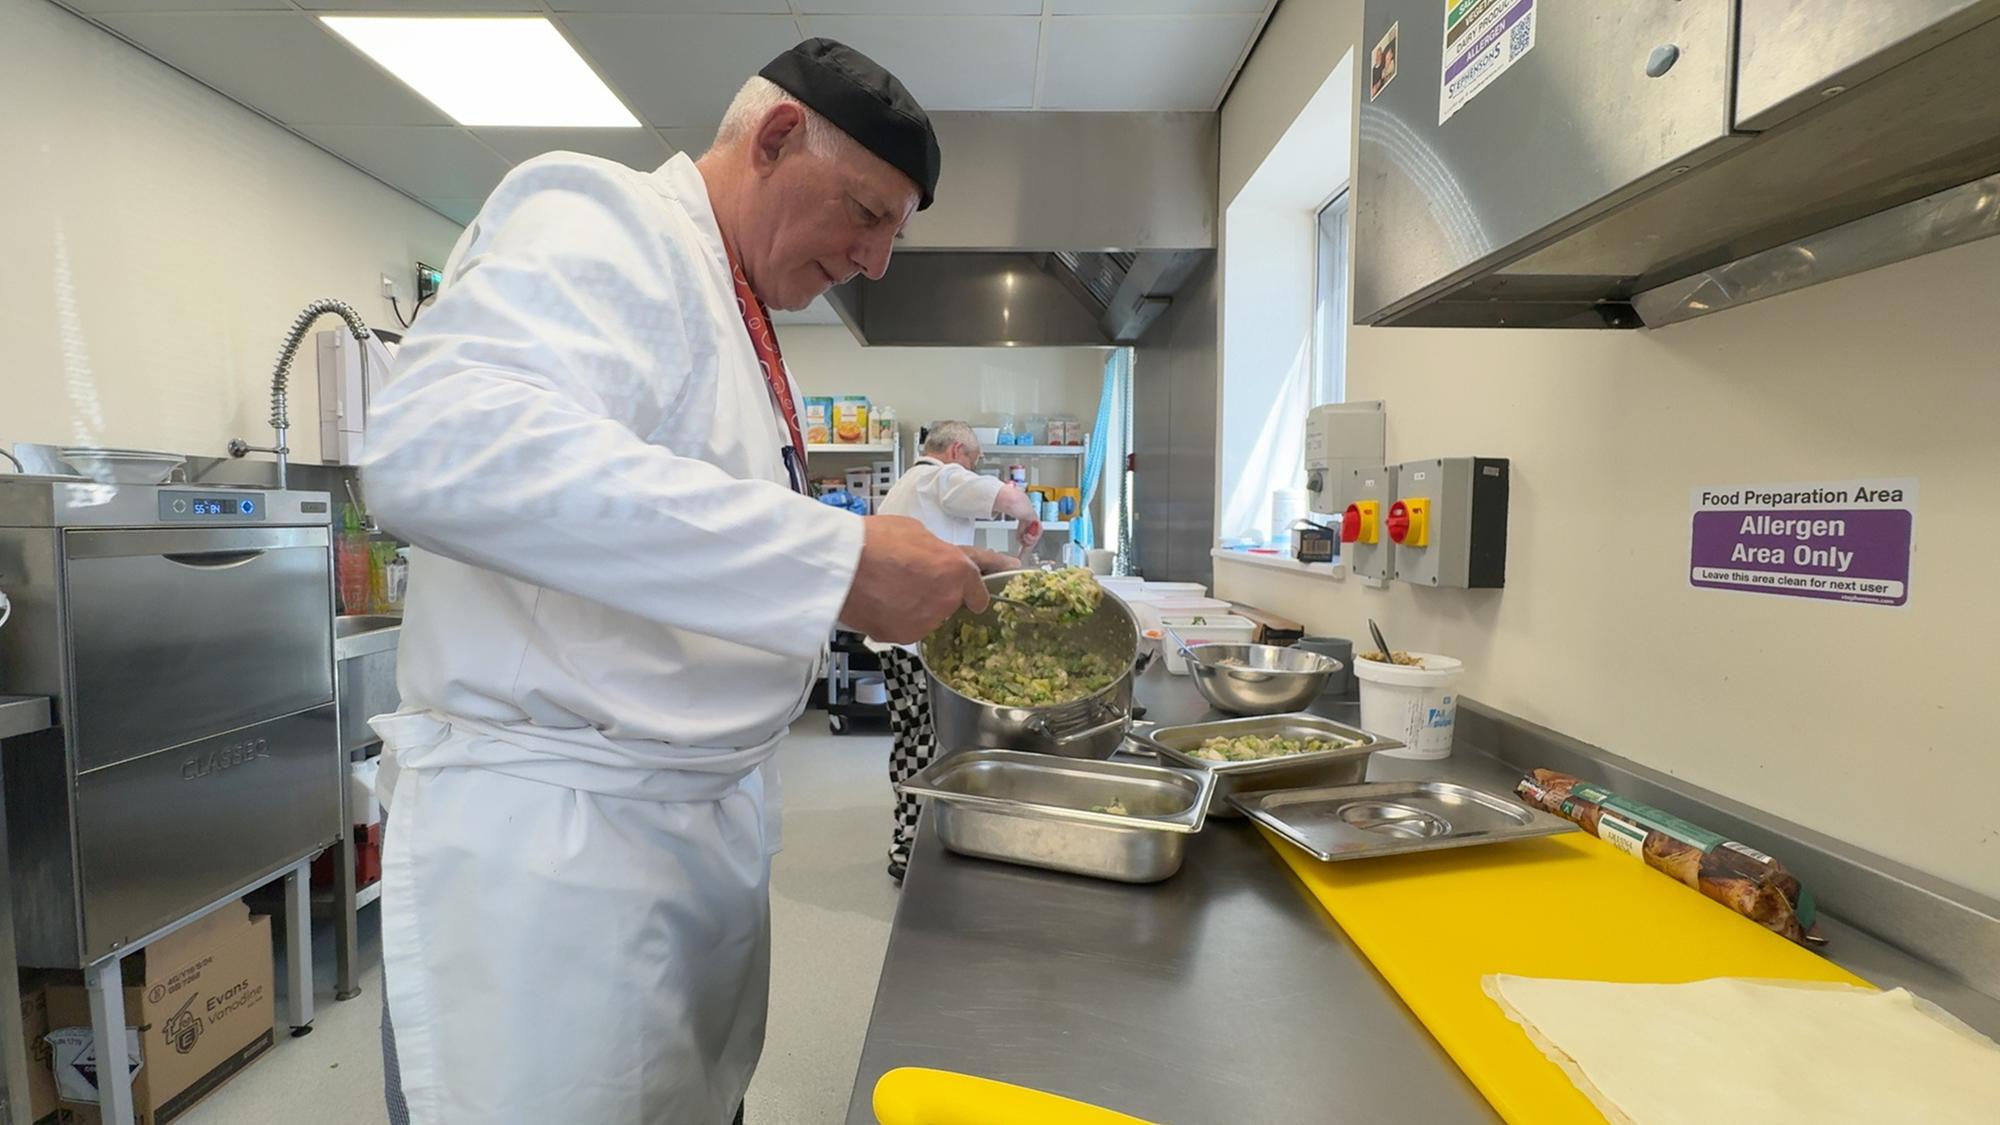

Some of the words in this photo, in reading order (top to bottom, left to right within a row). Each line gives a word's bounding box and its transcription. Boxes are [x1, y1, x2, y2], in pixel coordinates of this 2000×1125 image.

[1456, 29, 1477, 54] DAIRY
[1466, 19, 1506, 62] ALLERGEN
[1448, 41, 1501, 99] STEPHENSONS
[1702, 491, 1740, 506] Food
[1745, 488, 1848, 508] Preparation
[1854, 486, 1904, 503] Area
[1740, 515, 1846, 540] Allergen
[1731, 543, 1785, 565] Area
[1793, 544, 1854, 572] Only
[1702, 569, 1730, 581] Leave
[1732, 571, 1749, 583] this
[1752, 574, 1775, 585] area
[1778, 575, 1807, 588] clean
[1810, 577, 1827, 589] for
[1829, 580, 1857, 591] next
[1859, 583, 1889, 594] user
[180, 737, 271, 781] CLASSEQ
[206, 978, 249, 1012] Evans
